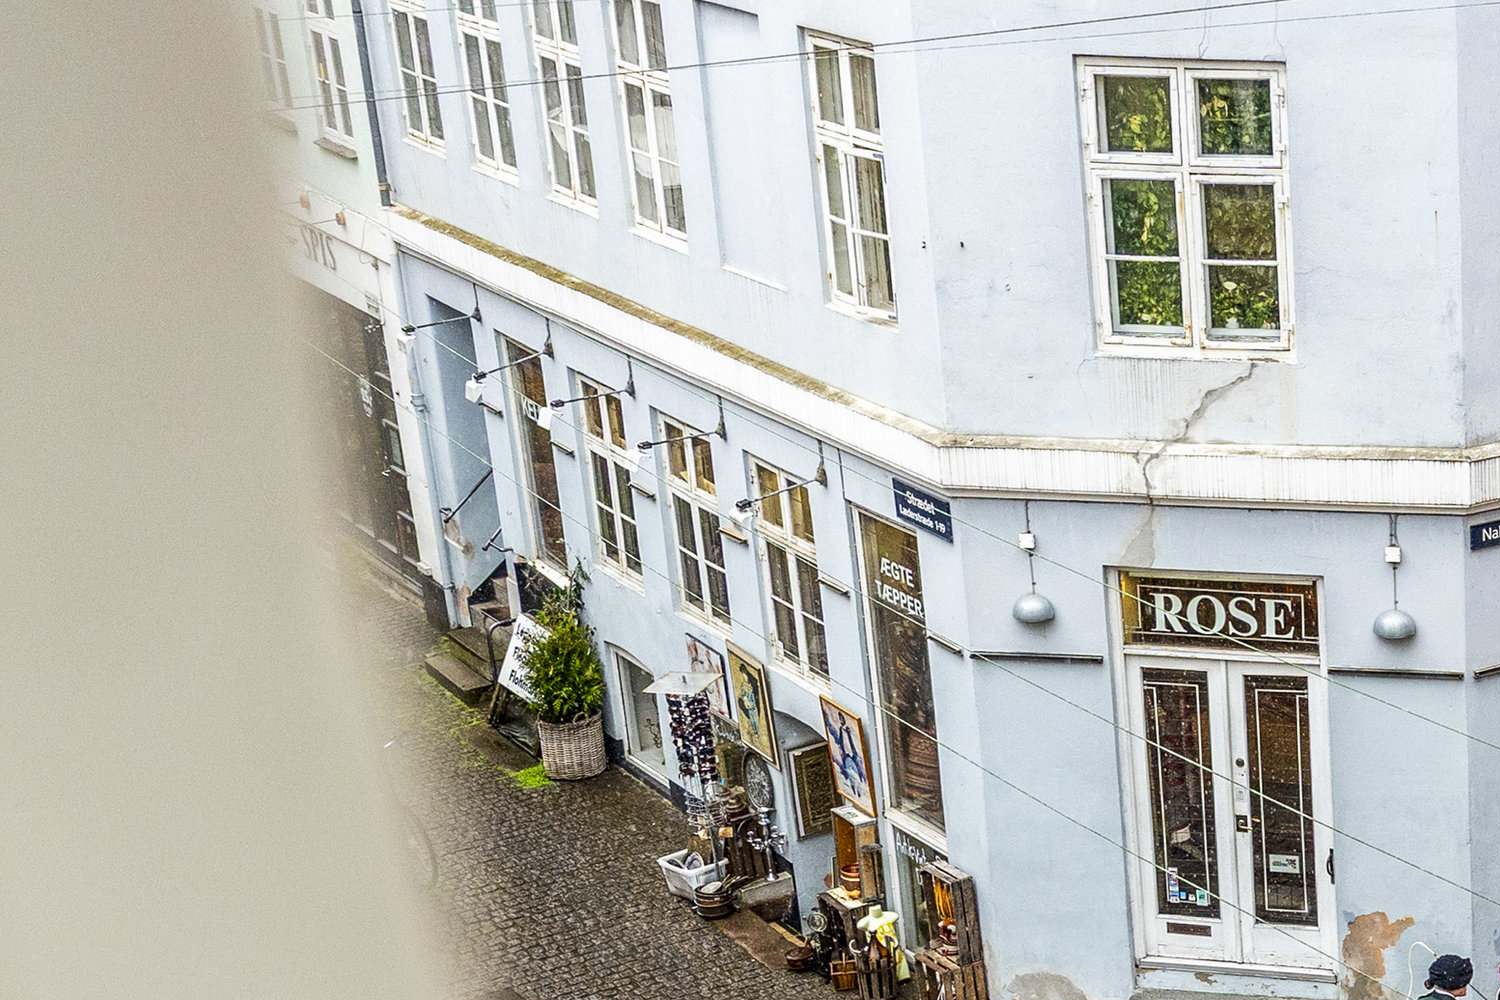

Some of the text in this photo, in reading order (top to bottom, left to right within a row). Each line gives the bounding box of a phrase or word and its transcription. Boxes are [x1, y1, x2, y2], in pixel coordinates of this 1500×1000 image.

[880, 557, 915, 588] ÆGTE
[874, 579, 926, 619] TÆPPER
[1149, 592, 1296, 640] ROSE
